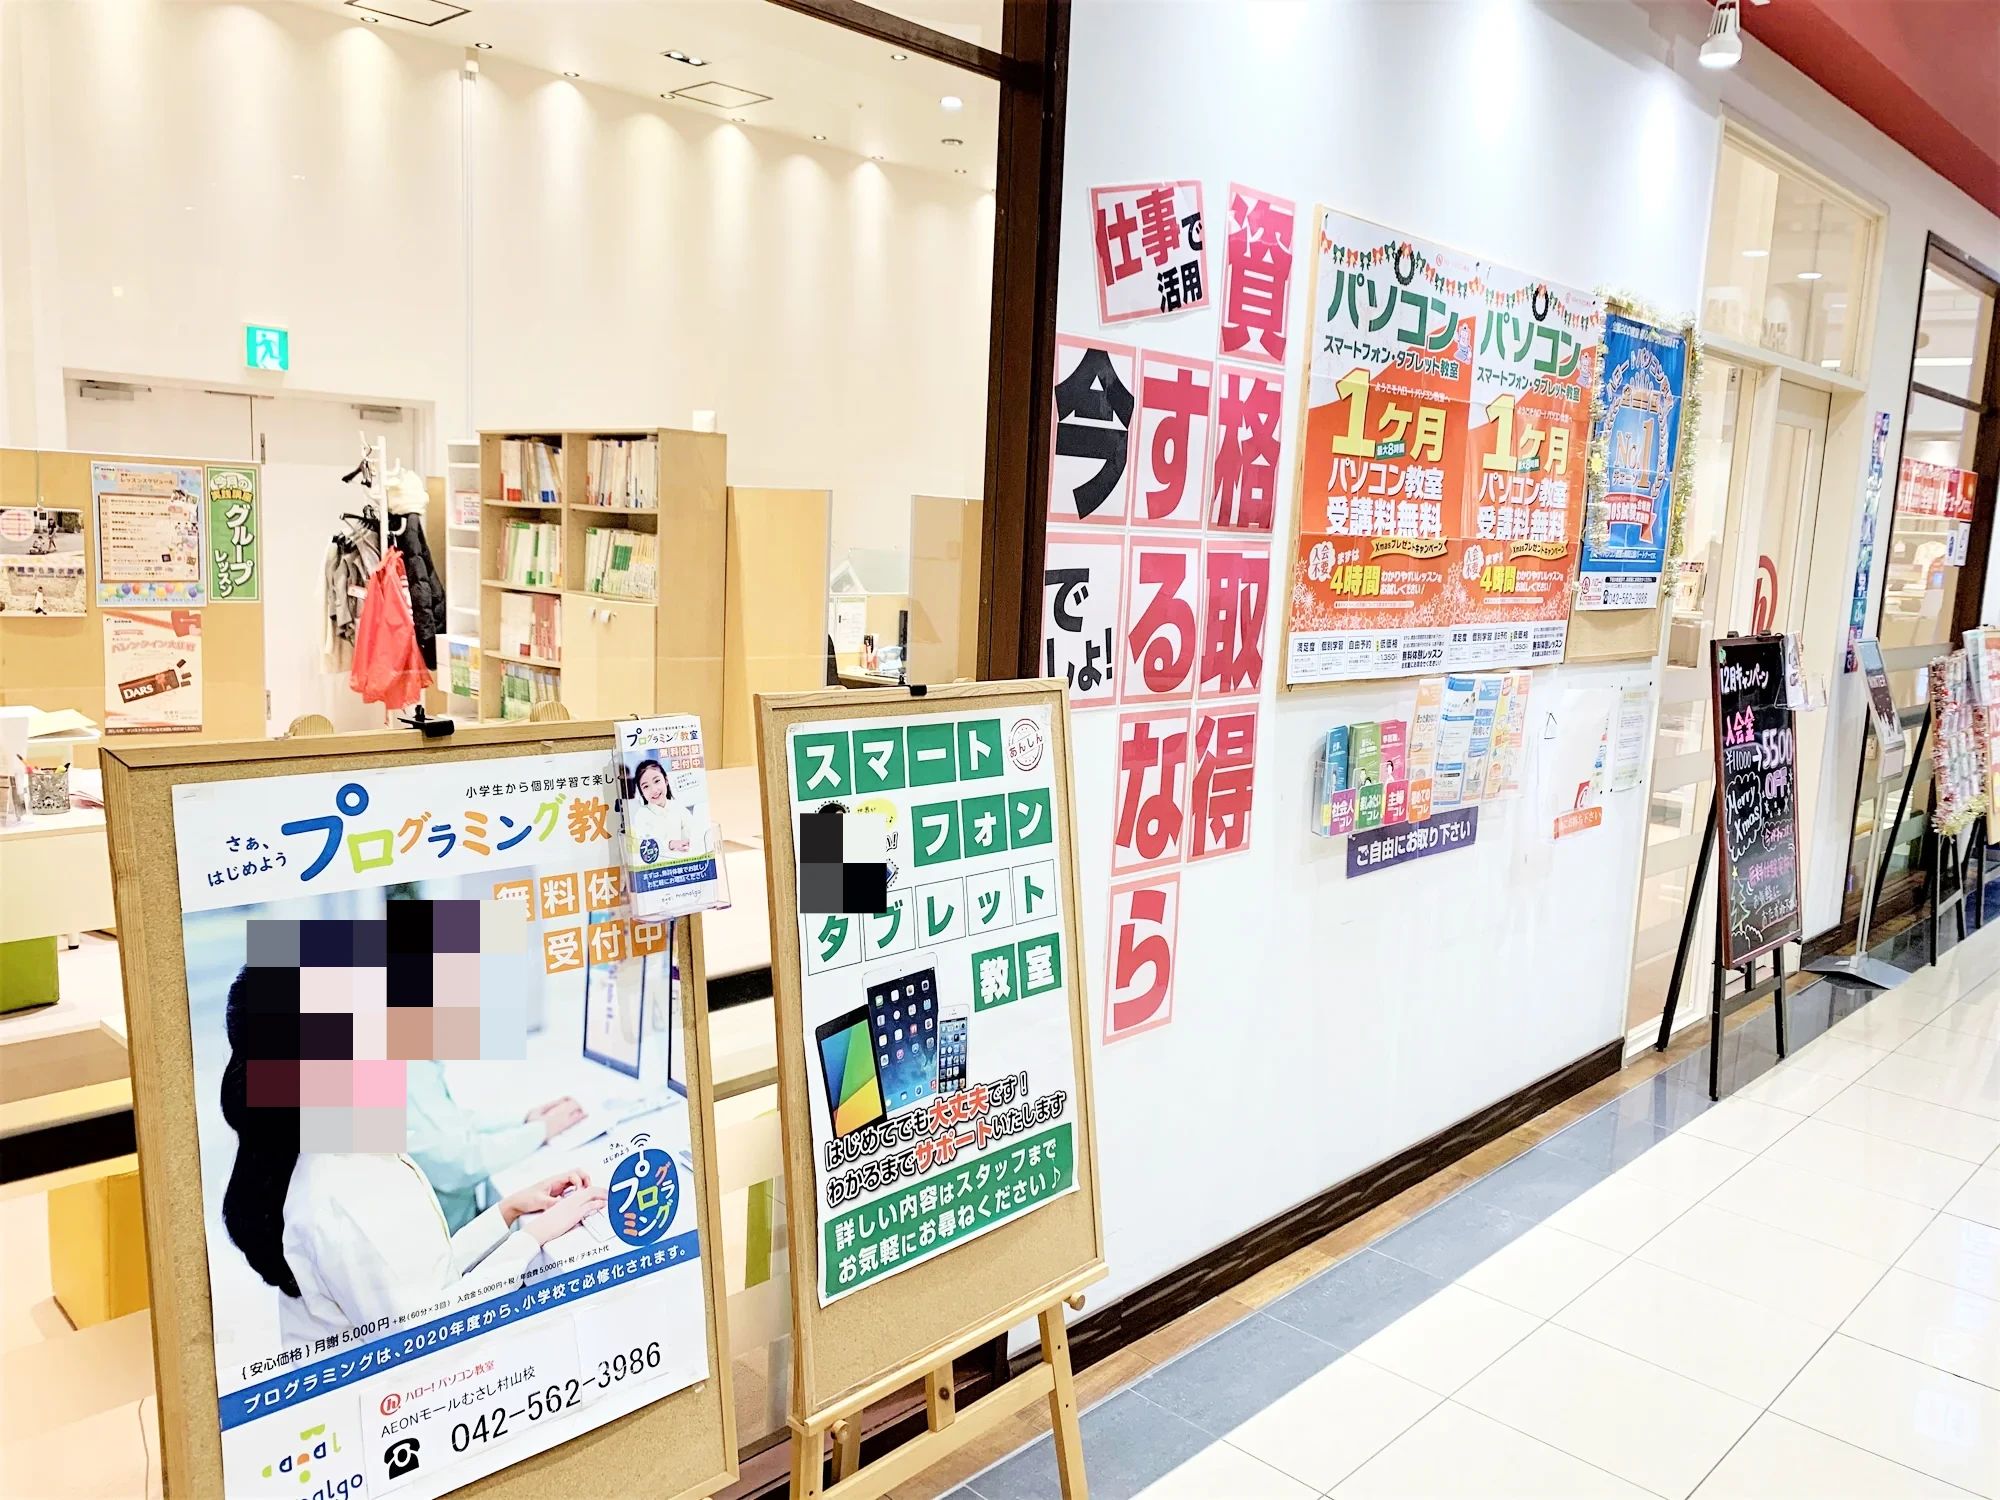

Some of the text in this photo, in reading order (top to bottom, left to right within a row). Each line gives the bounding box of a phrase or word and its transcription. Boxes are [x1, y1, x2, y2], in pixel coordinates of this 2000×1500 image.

[1095, 186, 1204, 286] 仕事で
[1157, 259, 1204, 313] 活用
[1327, 269, 1459, 350] パソコン
[1323, 334, 1459, 379] スマートフォン・タブレット教室
[1480, 310, 1582, 377] パソコン
[1477, 366, 1581, 401] スマートフォン・タブレット教室
[1327, 457, 1445, 501] パソコン教室
[1478, 472, 1568, 509] パソコン教室
[1325, 496, 1443, 539] 受講料無料
[1476, 504, 1566, 541] 受講料無料
[225, 504, 255, 586] グループ
[214, 549, 233, 598] レッスン
[1330, 565, 1382, 596] 4時間
[123, 684, 154, 700] DARS
[1725, 705, 1755, 747] 入会金
[1762, 727, 1793, 770] 5500
[805, 729, 992, 791] スマート
[1765, 766, 1788, 800] OFF
[921, 801, 1044, 857] フォン
[1728, 785, 1756, 826] Merry
[1734, 806, 1760, 843] Xmas
[281, 781, 622, 882] プログラミング教
[1355, 821, 1471, 867] ご自由にお取り下さい
[206, 850, 289, 888] はじめよう
[817, 875, 1045, 963] タブレット
[547, 922, 663, 971] 受付中
[979, 944, 1056, 1004] 教室
[826, 1090, 1067, 1208] わかるまでサポートいたします
[834, 1137, 1057, 1253] 詳しい内容はスタッフまで
[451, 1341, 662, 1453] 042-562-3986
